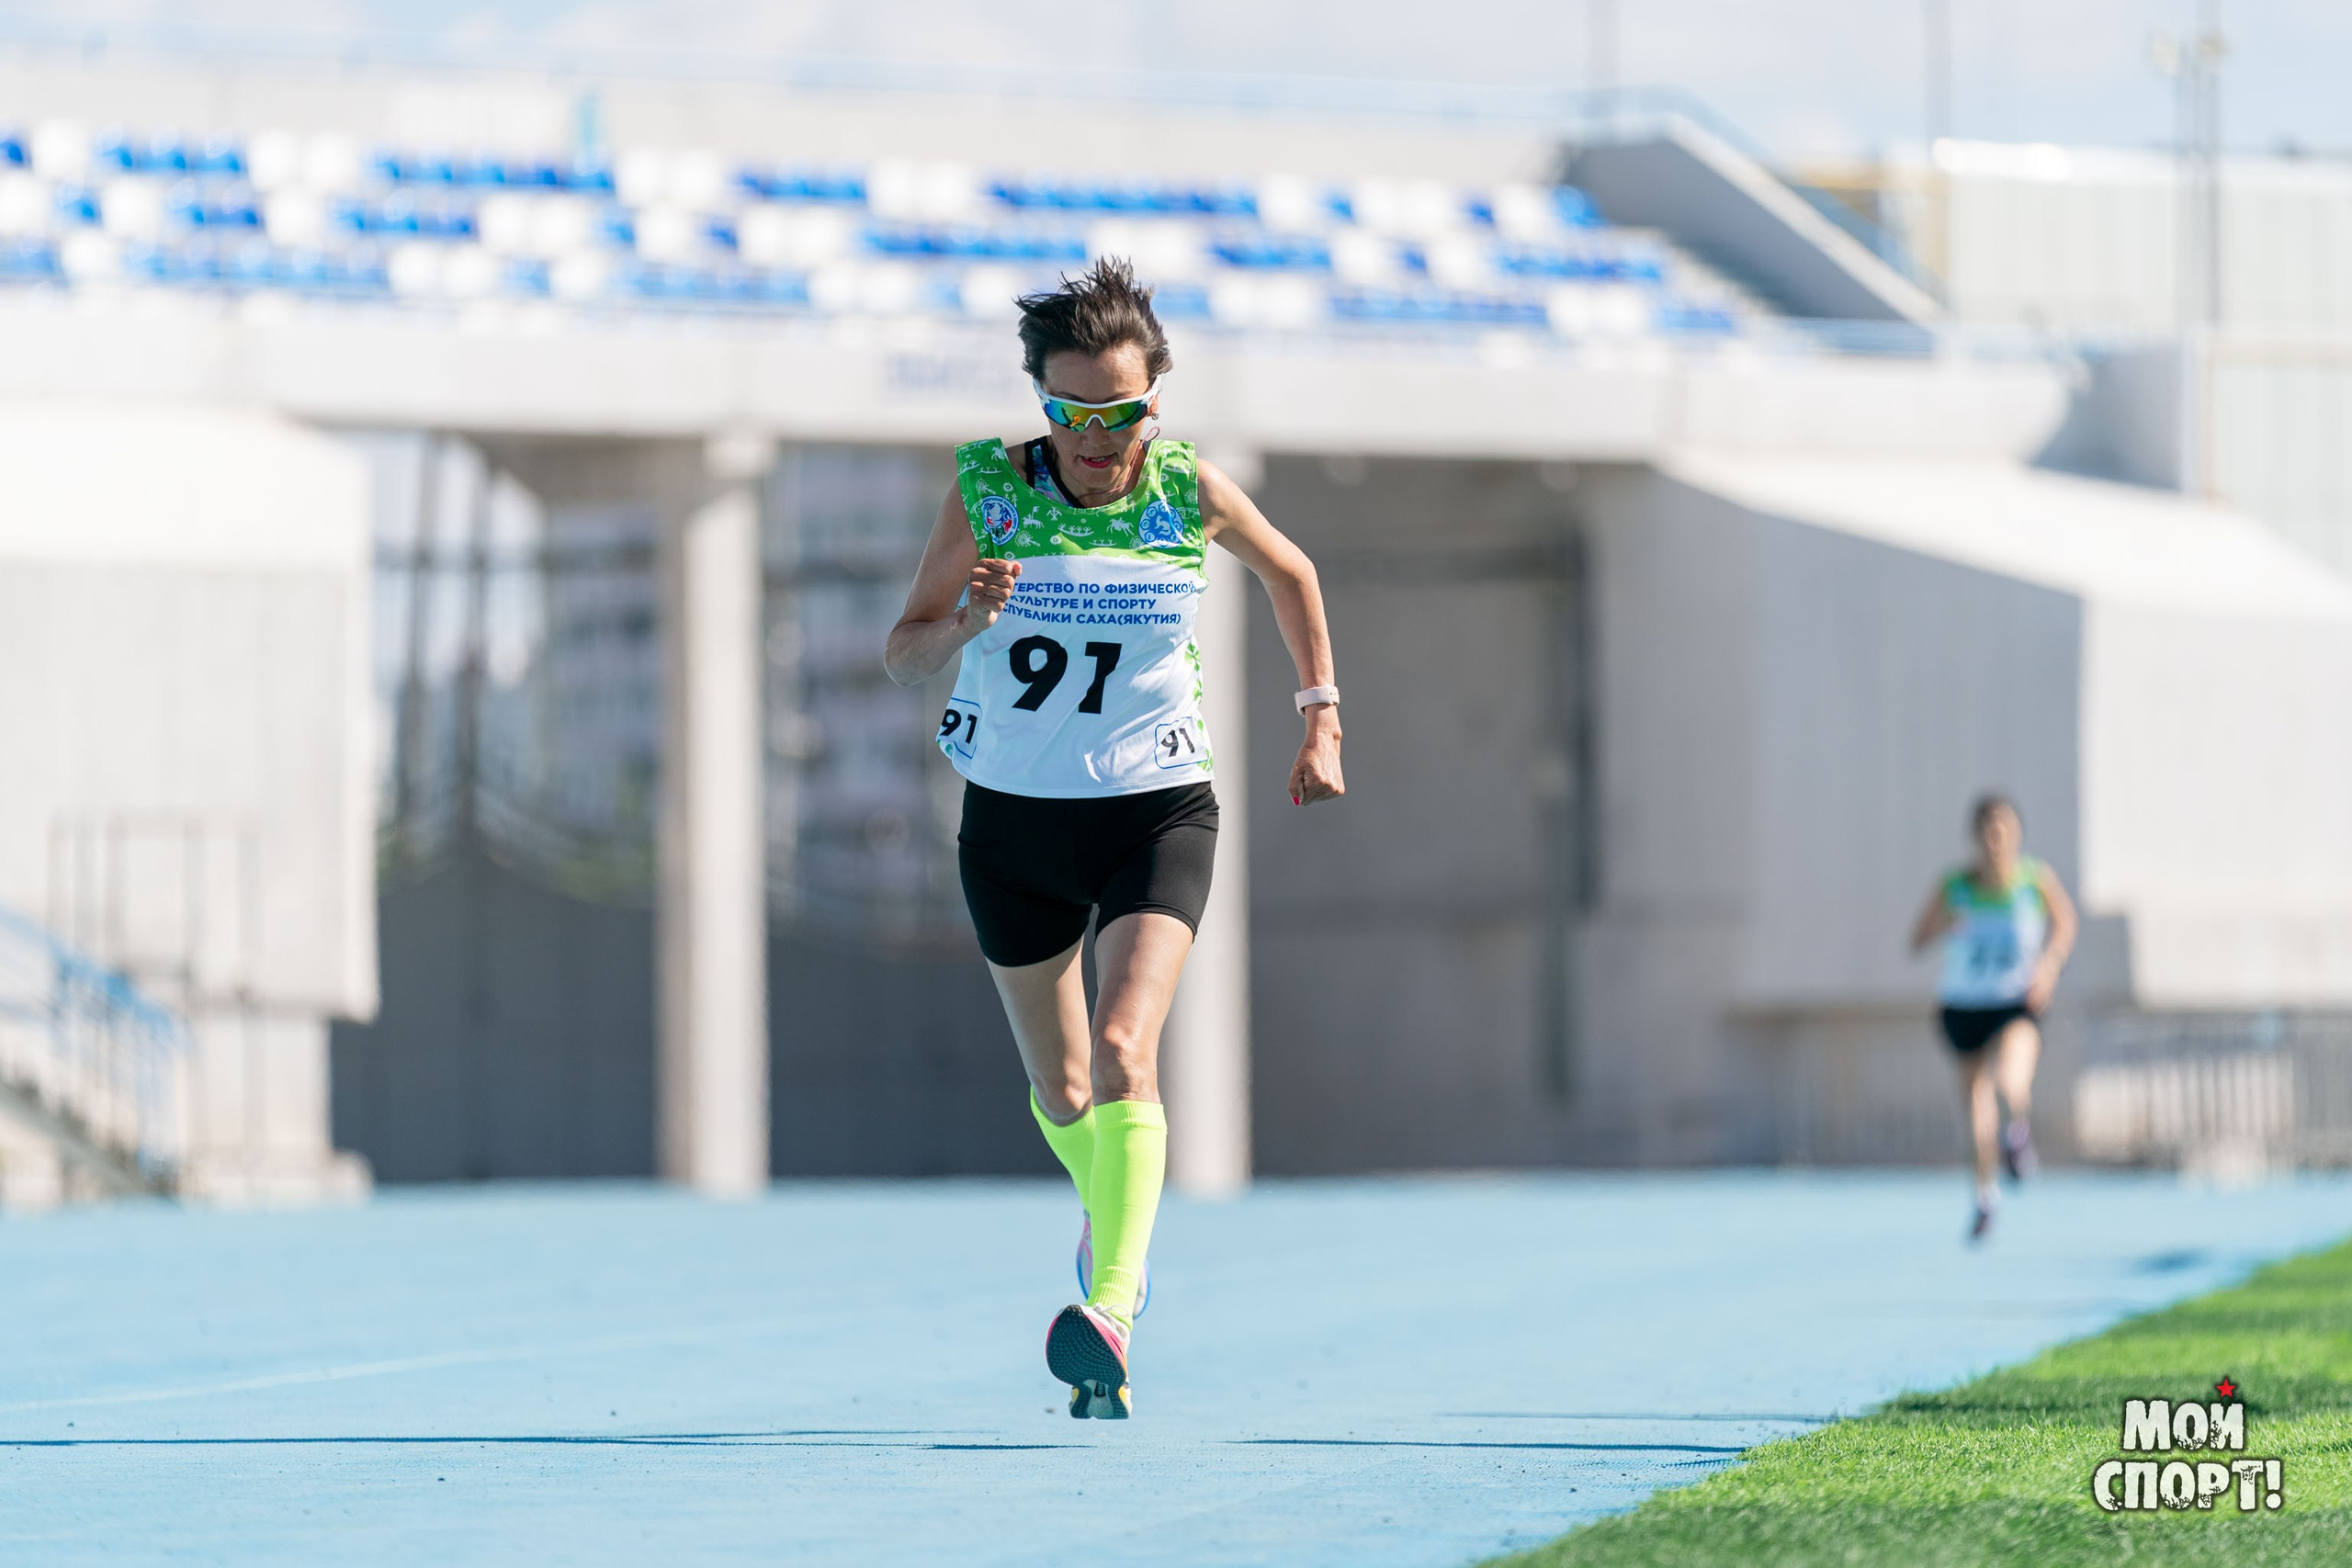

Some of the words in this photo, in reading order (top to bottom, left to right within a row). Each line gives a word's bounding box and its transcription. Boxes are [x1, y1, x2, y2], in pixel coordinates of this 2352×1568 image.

[1079, 582, 1101, 594] ПО
[1083, 598, 1093, 609] И
[1097, 598, 1157, 609] СПОРТУ
[1076, 613, 1182, 626] САХА(ЯКУТИЯ)
[1009, 635, 1123, 715] 91
[939, 708, 978, 745] 91
[1160, 728, 1195, 757] 91
